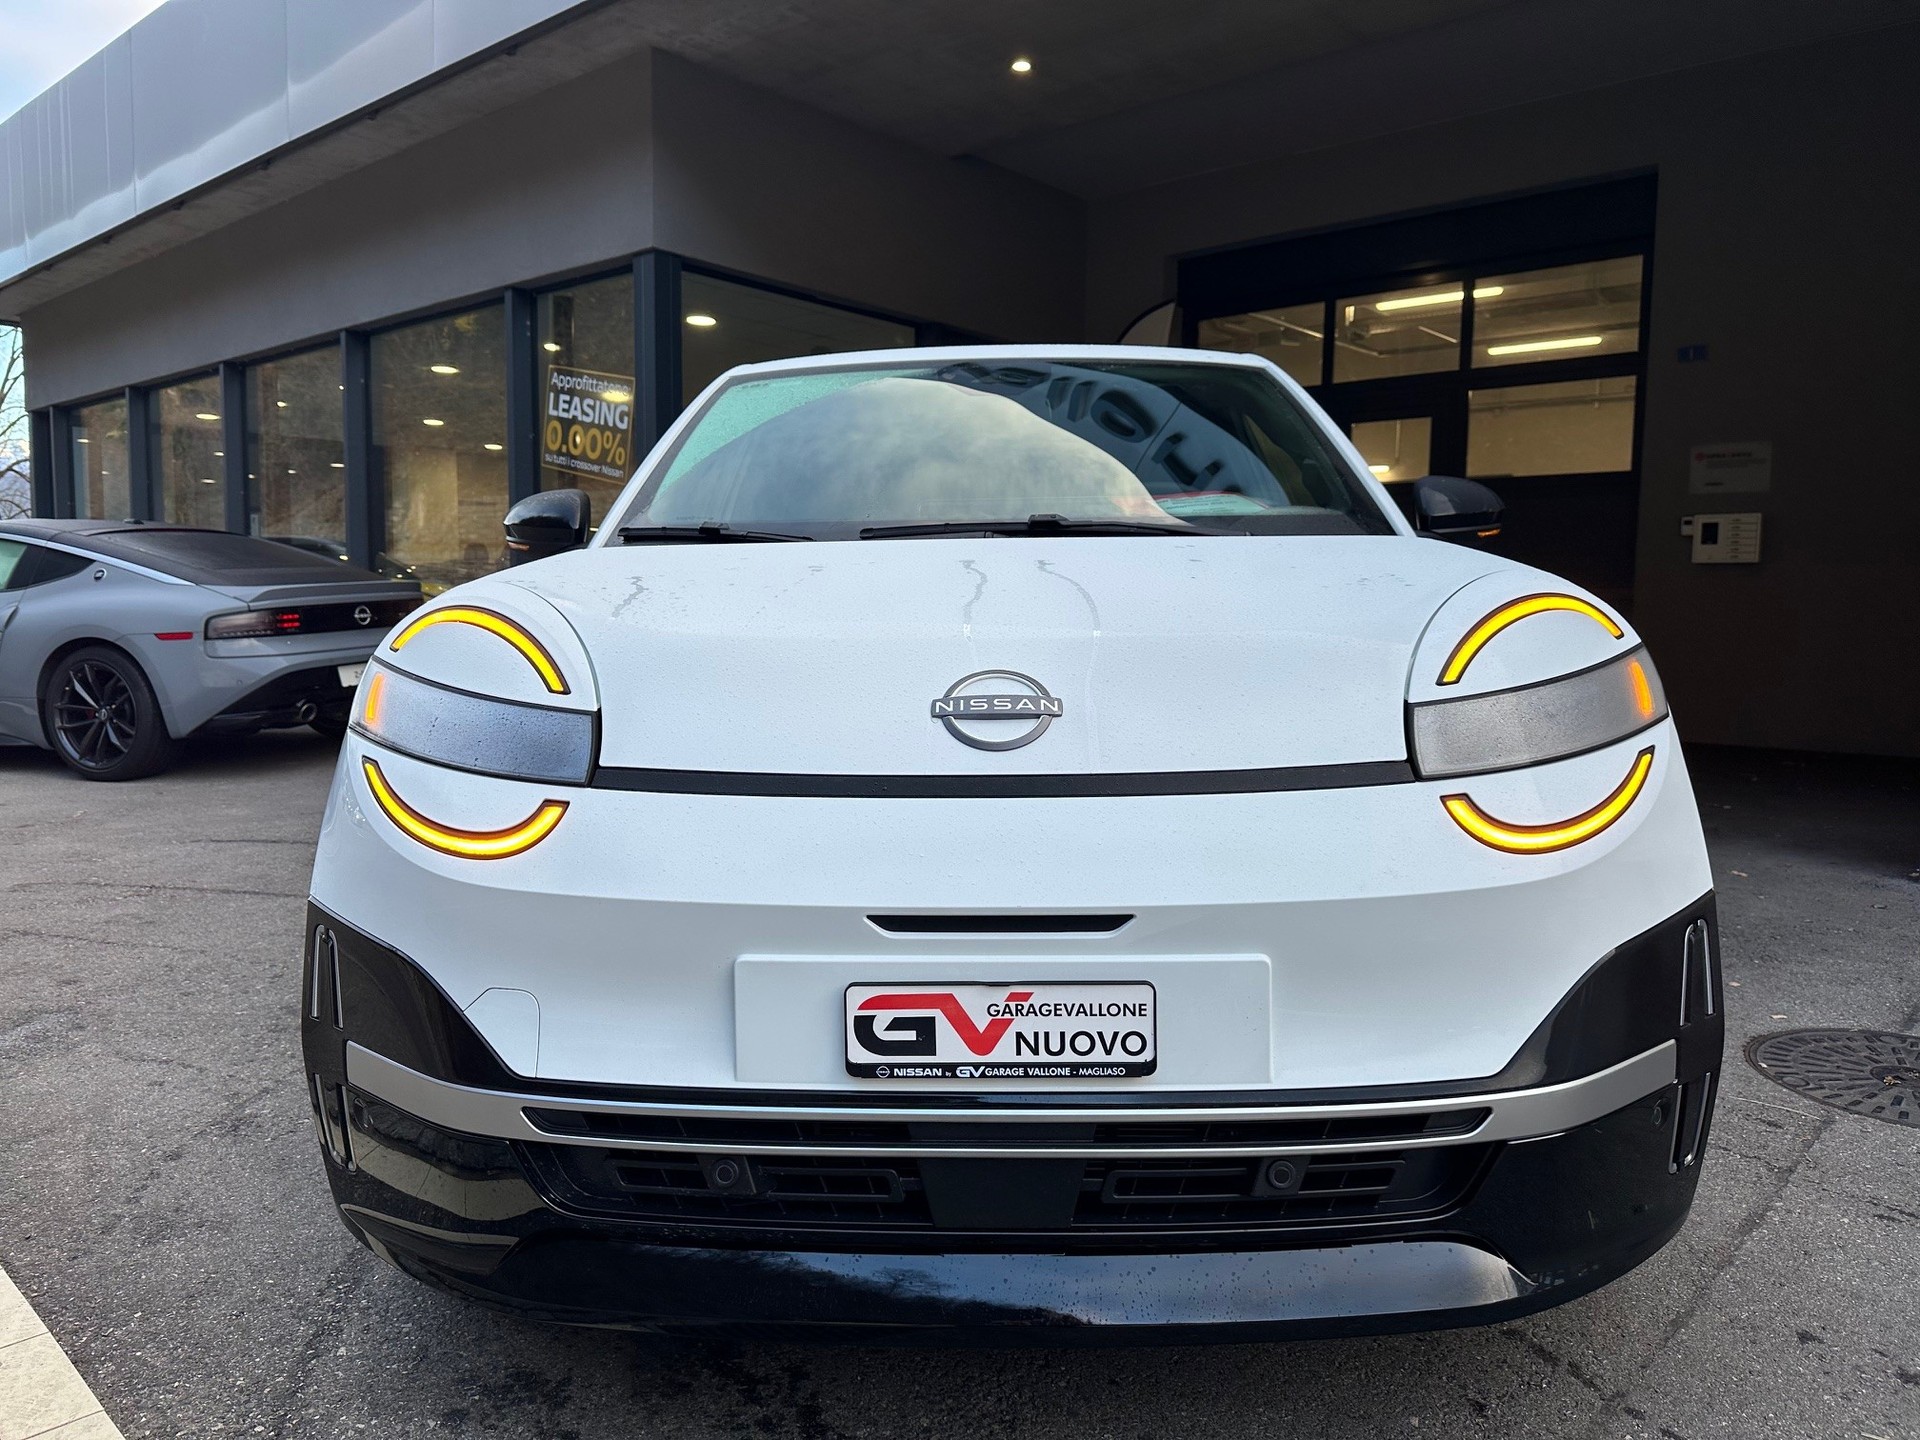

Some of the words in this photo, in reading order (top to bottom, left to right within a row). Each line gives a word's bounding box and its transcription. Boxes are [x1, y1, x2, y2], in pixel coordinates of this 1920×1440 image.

[548, 392, 629, 429] LEASING
[546, 420, 626, 465] 0.00%
[570, 459, 601, 474] crossover
[602, 465, 624, 478] Nissan
[935, 698, 1059, 713] NISSAN
[986, 1002, 1148, 1017] GARAGEVALLONE
[1015, 1031, 1148, 1057] NUOVO
[893, 1067, 943, 1077] NISSAN
[945, 1070, 953, 1078] by
[985, 1067, 1025, 1076] GARAGE
[1027, 1067, 1071, 1076] VALLONE
[1078, 1067, 1126, 1076] MAGLIASO
